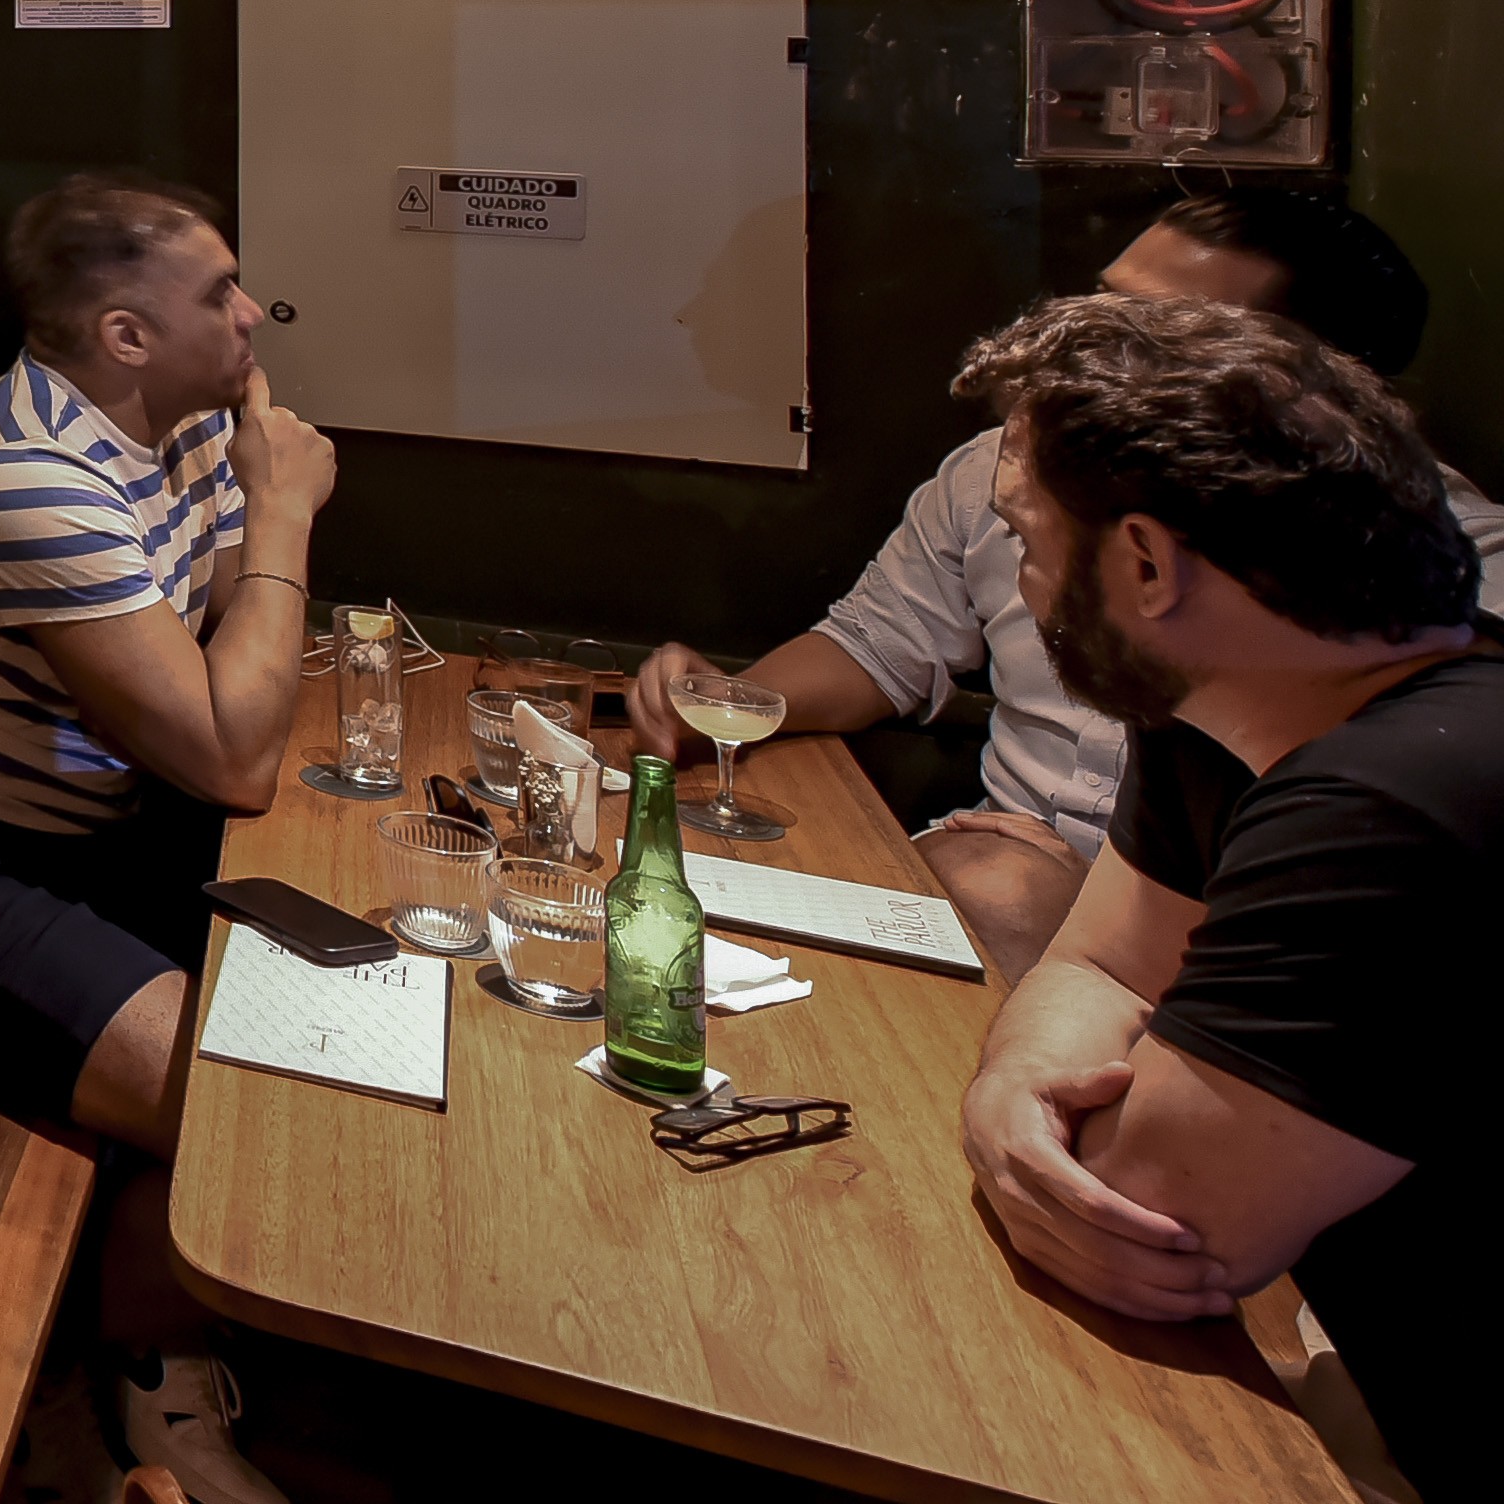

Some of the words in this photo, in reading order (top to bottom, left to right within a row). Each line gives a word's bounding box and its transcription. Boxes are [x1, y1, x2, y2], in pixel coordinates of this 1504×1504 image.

[458, 177, 558, 195] CUIDADO
[467, 195, 547, 212] QUADRO
[465, 212, 549, 231] ELÉTRICO
[865, 916, 904, 942] THE
[887, 900, 937, 948] PARLOR
